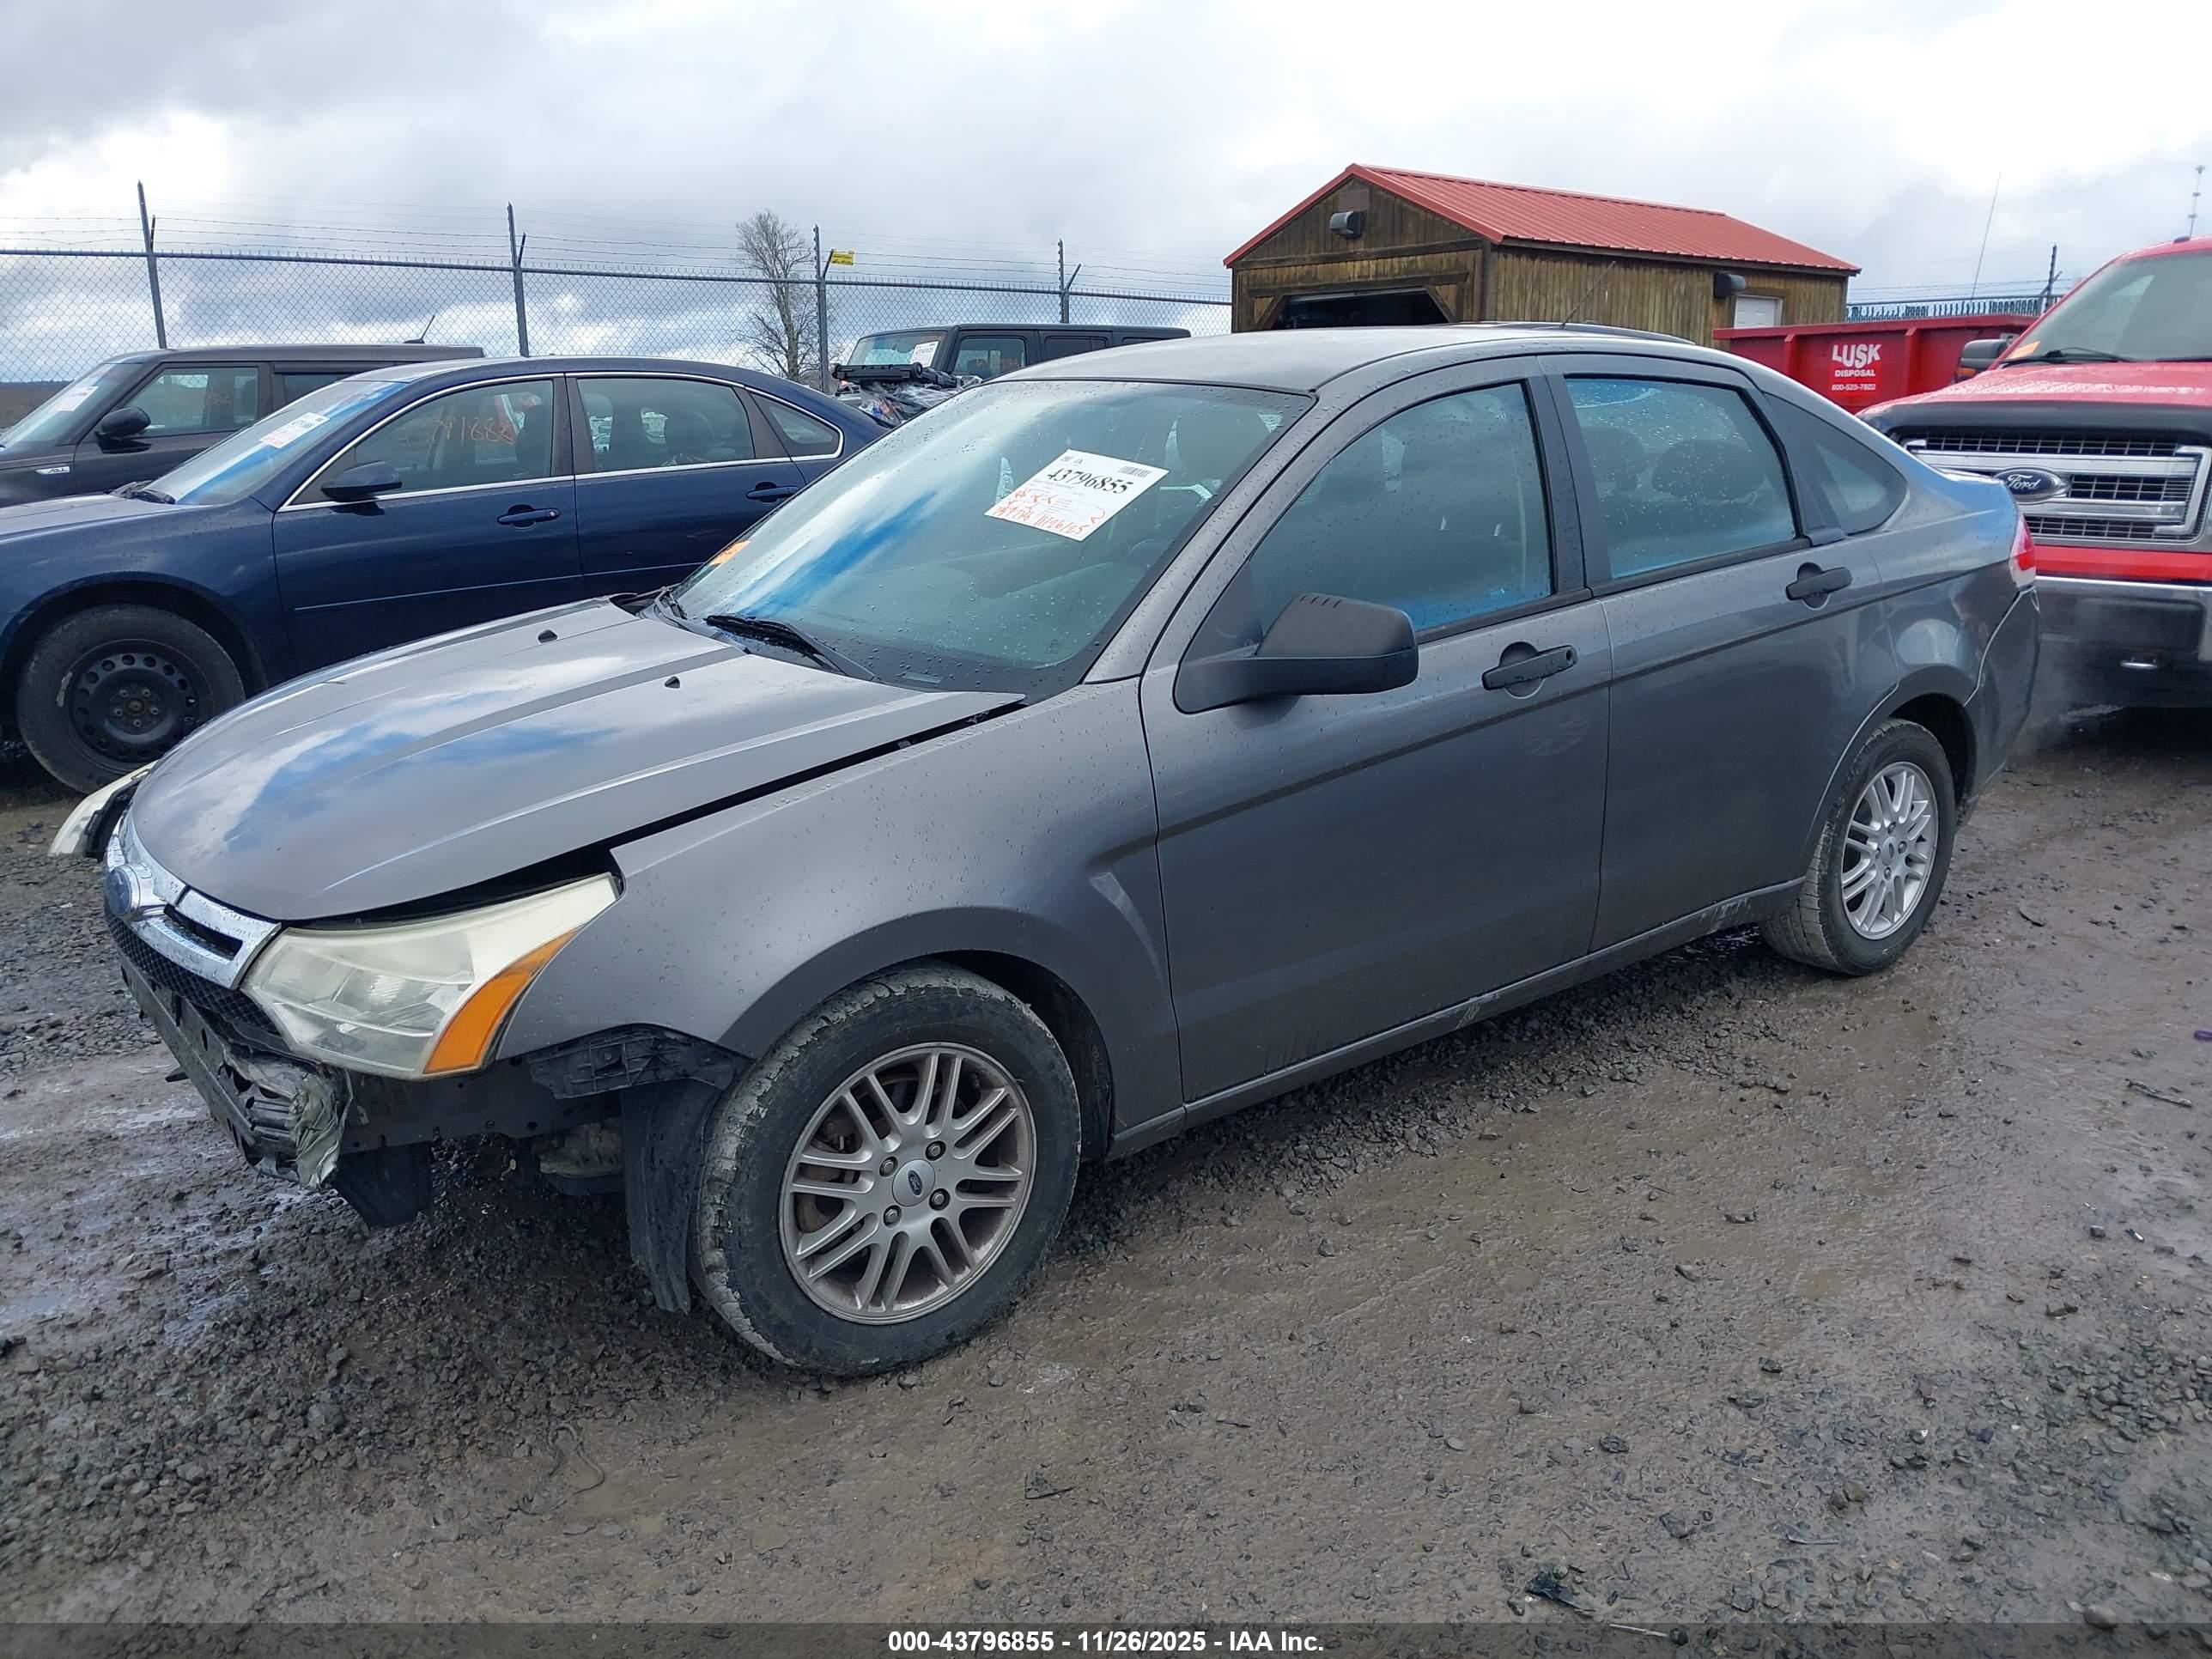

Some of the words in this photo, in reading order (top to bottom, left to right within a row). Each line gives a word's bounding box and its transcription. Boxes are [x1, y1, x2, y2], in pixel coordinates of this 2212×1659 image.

[1832, 344, 1881, 368] LUSK
[1047, 468, 1133, 494] 43796855
[2007, 473, 2042, 489] Ford
